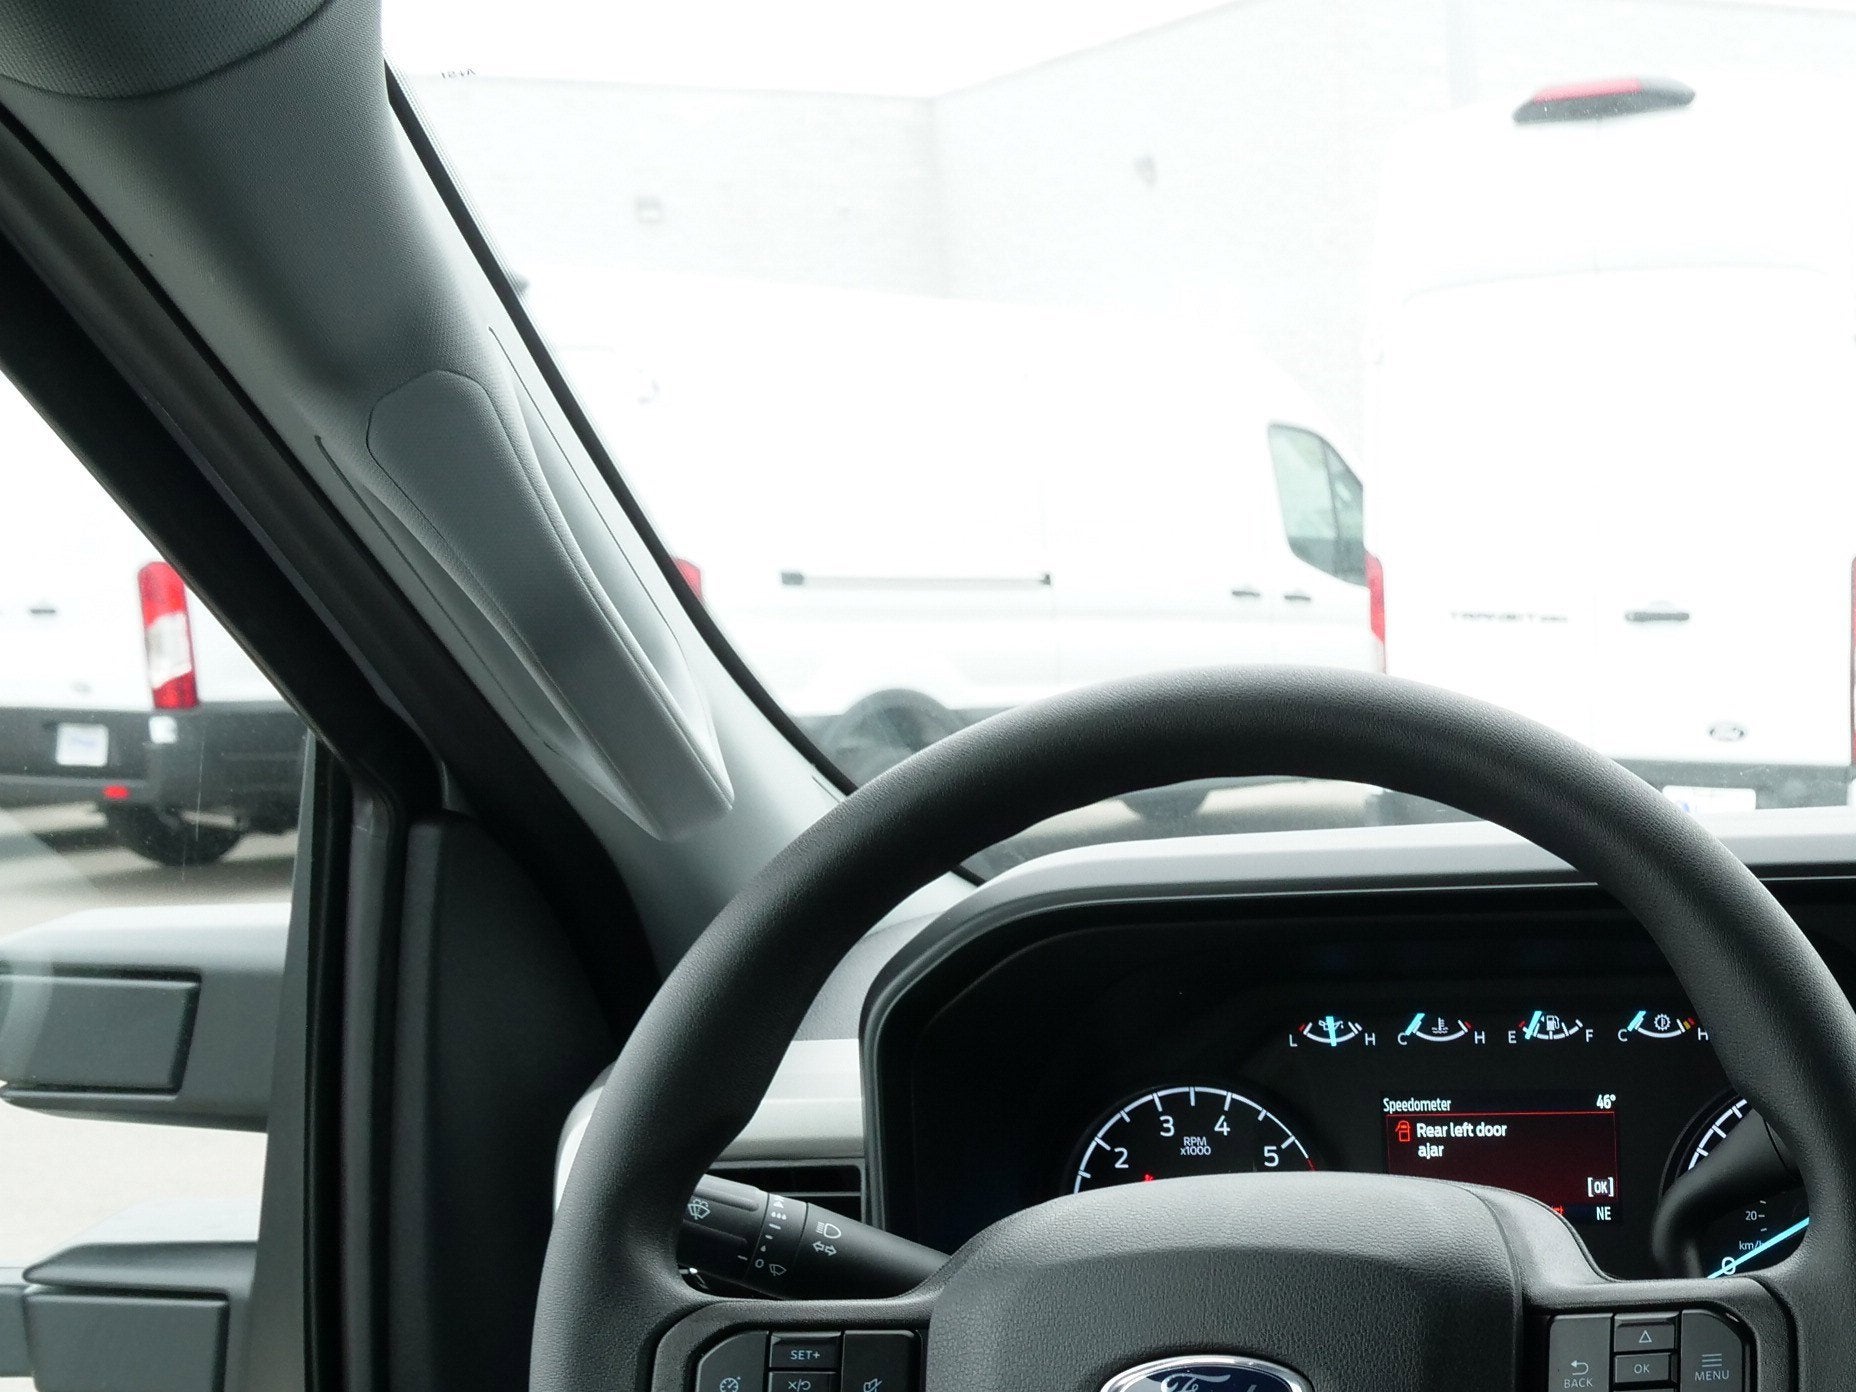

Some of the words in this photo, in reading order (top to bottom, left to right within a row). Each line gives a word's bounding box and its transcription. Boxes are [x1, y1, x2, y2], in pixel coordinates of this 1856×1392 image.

[1289, 1033, 1298, 1047] L
[1364, 1033, 1376, 1046] H
[1397, 1033, 1408, 1046] C
[1474, 1033, 1486, 1045] H
[1508, 1031, 1517, 1044] E
[1586, 1029, 1594, 1042] F
[1618, 1028, 1628, 1042] C
[1697, 1027, 1709, 1040] H
[1383, 1097, 1452, 1114] Speedometer
[1596, 1093, 1617, 1109] 46°
[1159, 1115, 1175, 1137] 3
[1214, 1115, 1231, 1136] 4
[1416, 1122, 1448, 1138] Rear
[1450, 1122, 1475, 1138] left
[1476, 1121, 1507, 1137] door
[1183, 1136, 1207, 1146] RPM
[1180, 1146, 1211, 1155] x1000
[1263, 1145, 1279, 1167] 5
[1418, 1142, 1445, 1160] ajar
[1114, 1147, 1129, 1168] 2
[1596, 1206, 1611, 1220] NE
[1745, 1210, 1757, 1221] 20
[790, 1350, 820, 1360] SET+
[1633, 1364, 1650, 1374] OK
[1694, 1370, 1730, 1381] MENU
[1564, 1377, 1593, 1389] BACK
